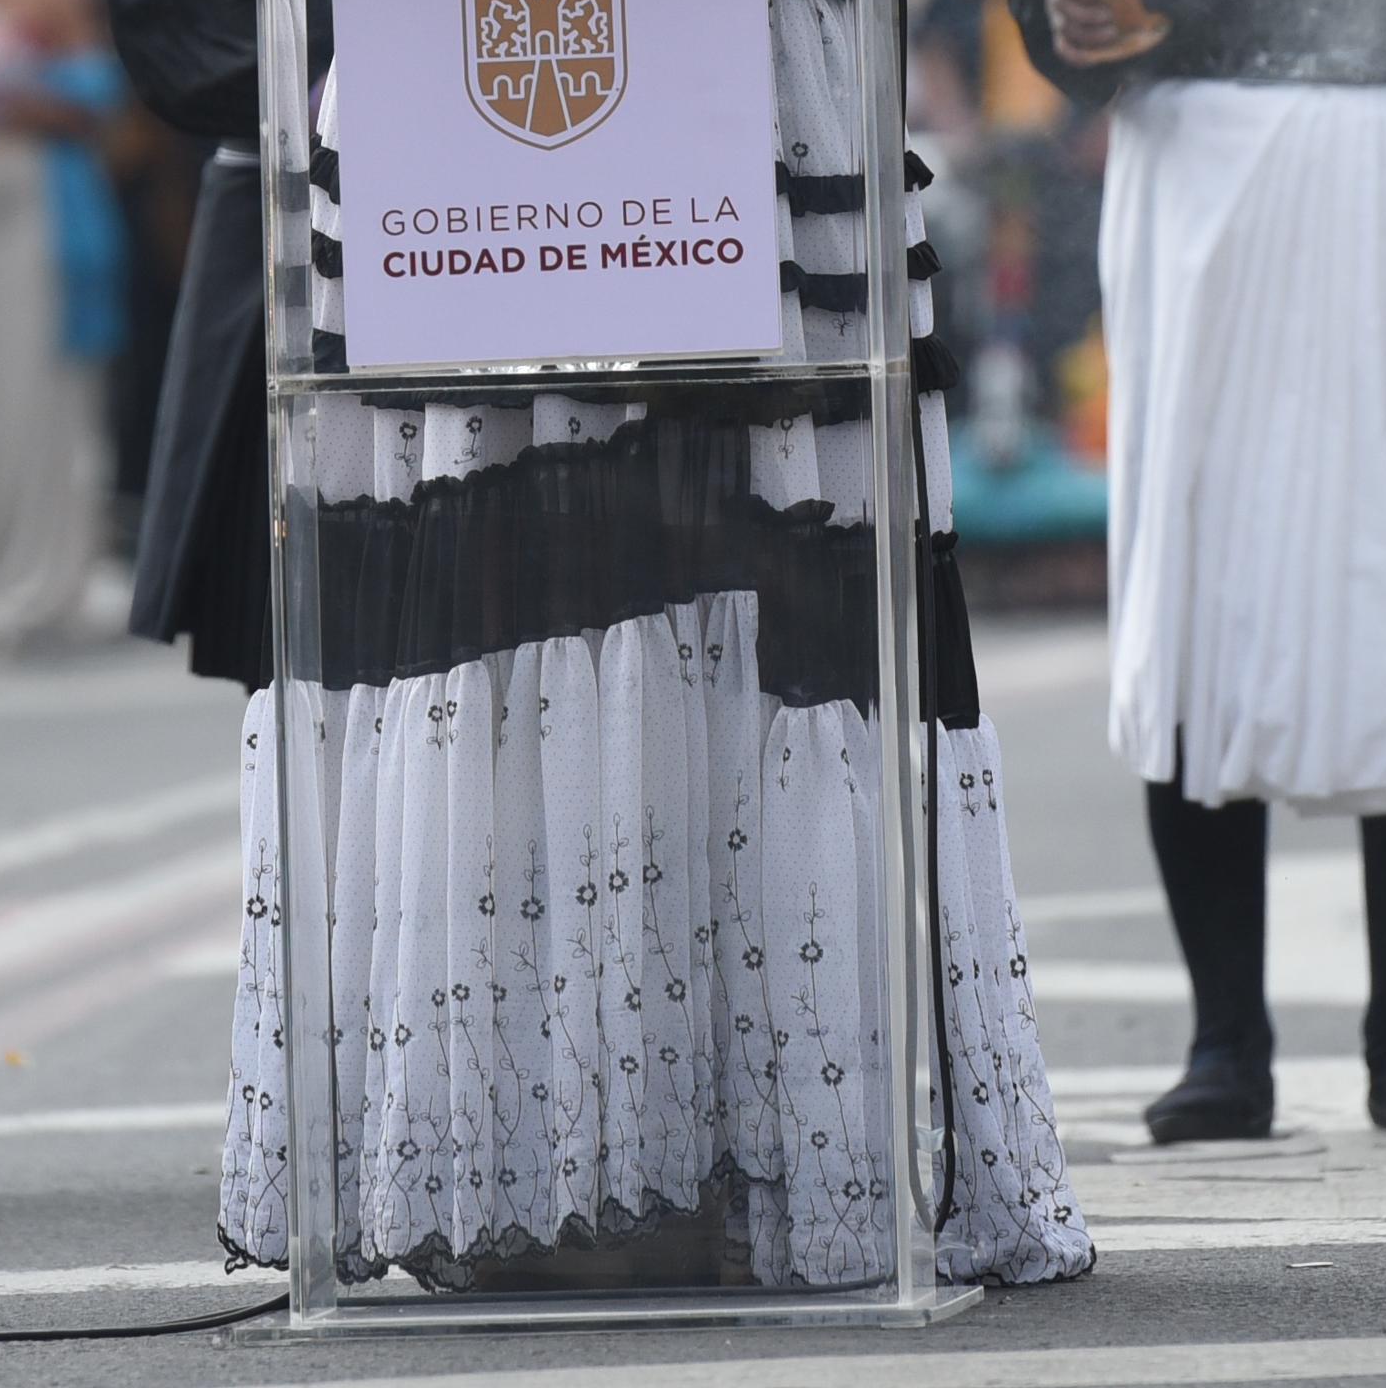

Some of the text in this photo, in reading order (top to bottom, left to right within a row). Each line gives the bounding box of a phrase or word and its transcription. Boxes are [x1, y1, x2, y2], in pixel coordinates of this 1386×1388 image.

[381, 195, 740, 237] GOBIERNO DE LA
[383, 234, 744, 278] CIUDAD DE MÉXICO
